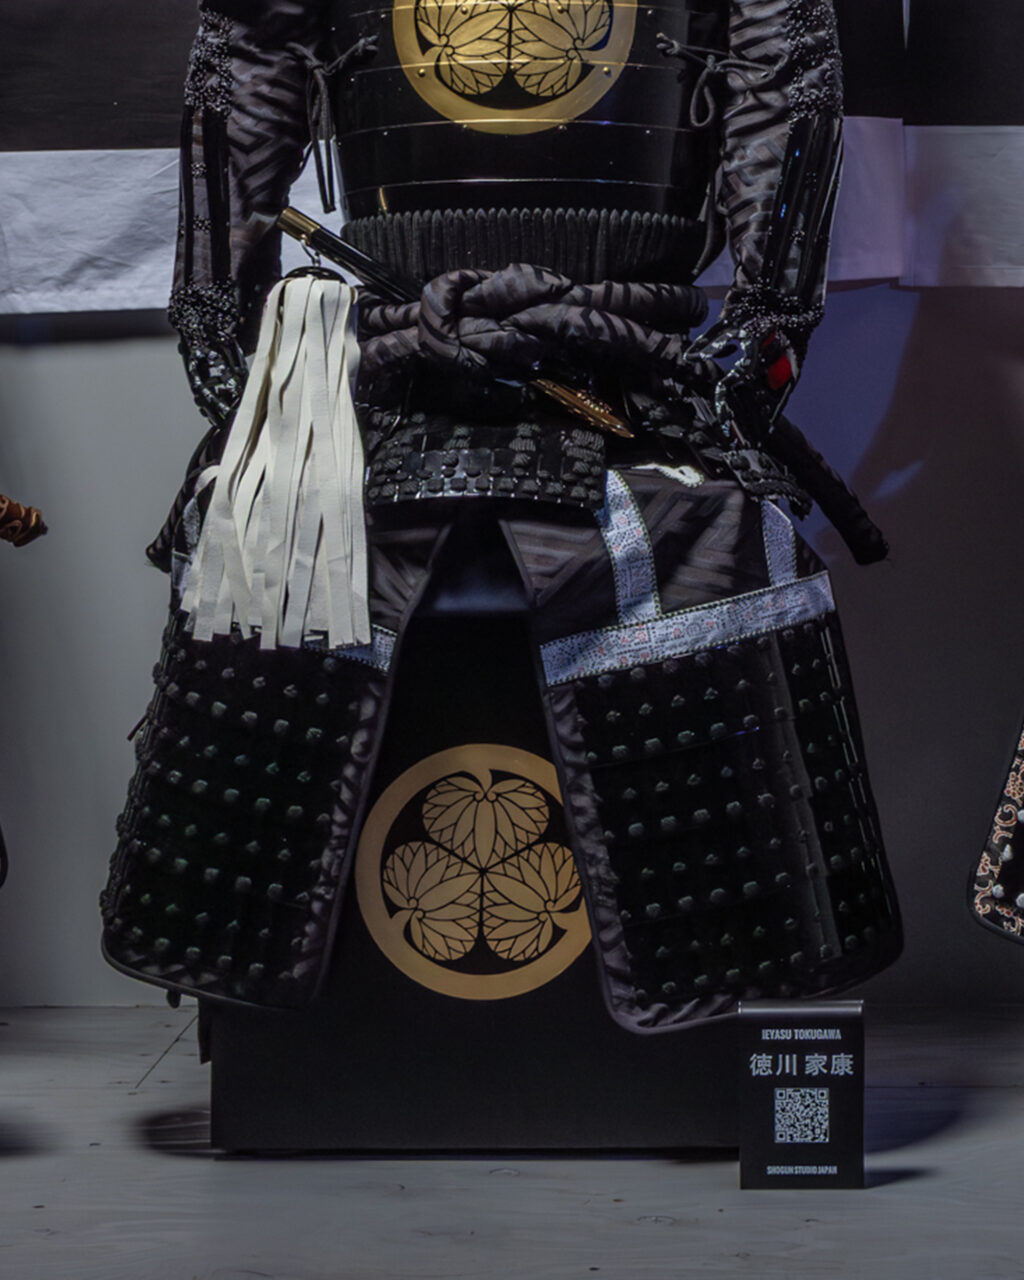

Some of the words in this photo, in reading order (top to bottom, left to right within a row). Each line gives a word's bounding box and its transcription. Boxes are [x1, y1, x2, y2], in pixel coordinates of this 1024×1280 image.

[761, 1028, 793, 1041] IEYASU
[794, 1028, 842, 1041] TOKUGAWA
[749, 1052, 798, 1077] 徳川
[804, 1052, 854, 1077] 家康
